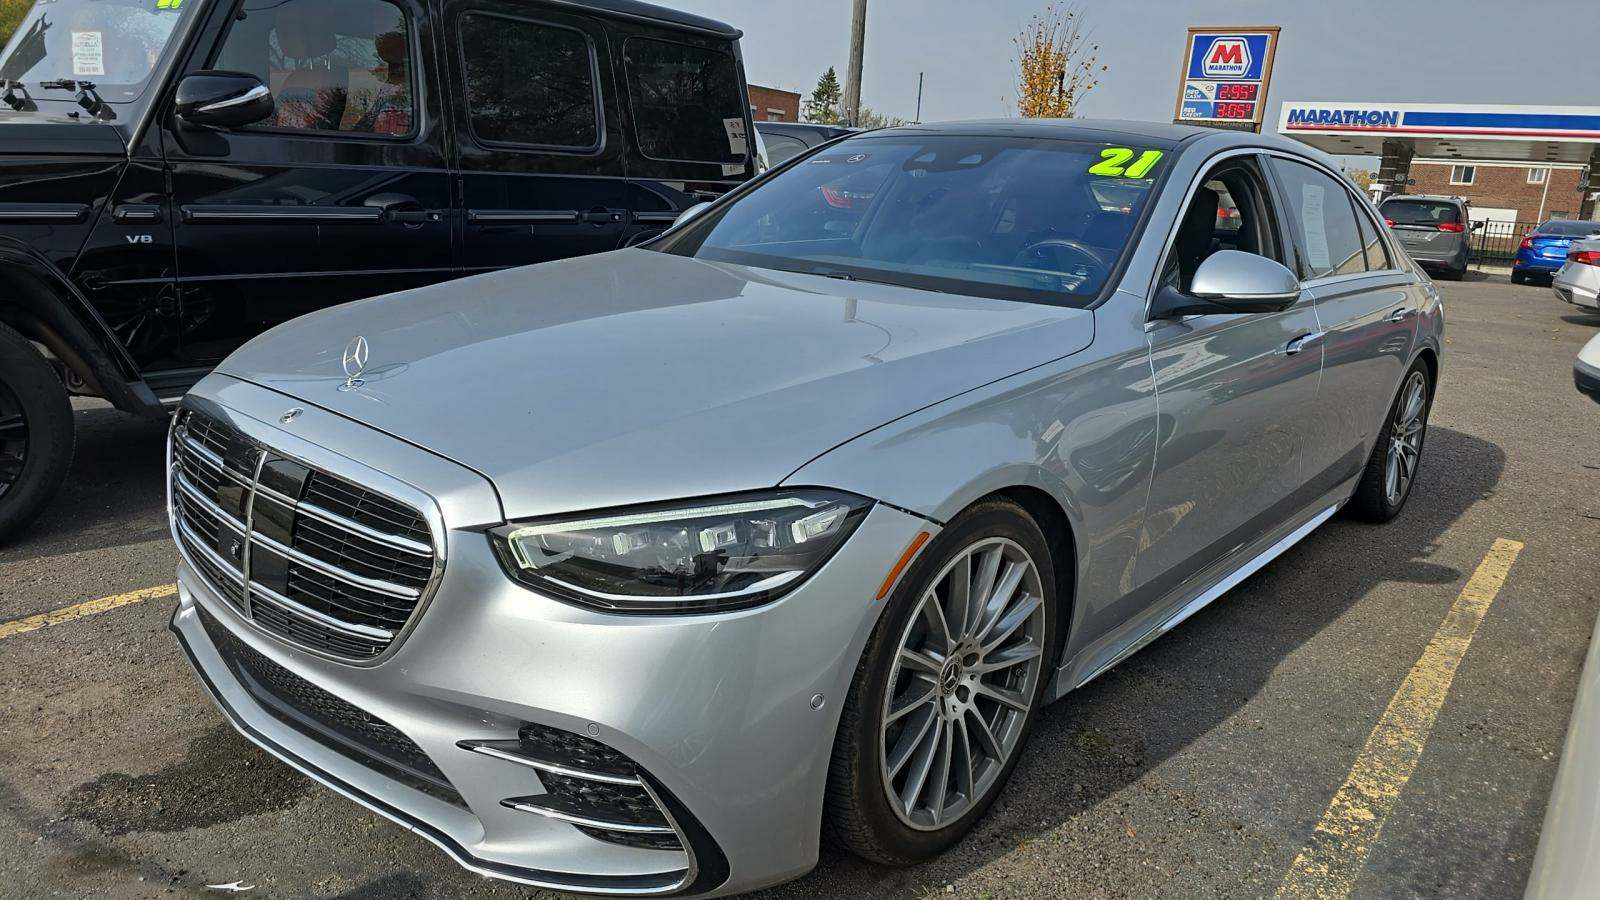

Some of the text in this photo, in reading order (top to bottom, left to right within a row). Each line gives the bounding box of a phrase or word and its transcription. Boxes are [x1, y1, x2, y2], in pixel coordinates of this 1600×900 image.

[1287, 109, 1398, 125] MARATHON
[1088, 147, 1164, 179] 21
[125, 234, 153, 244] V8
